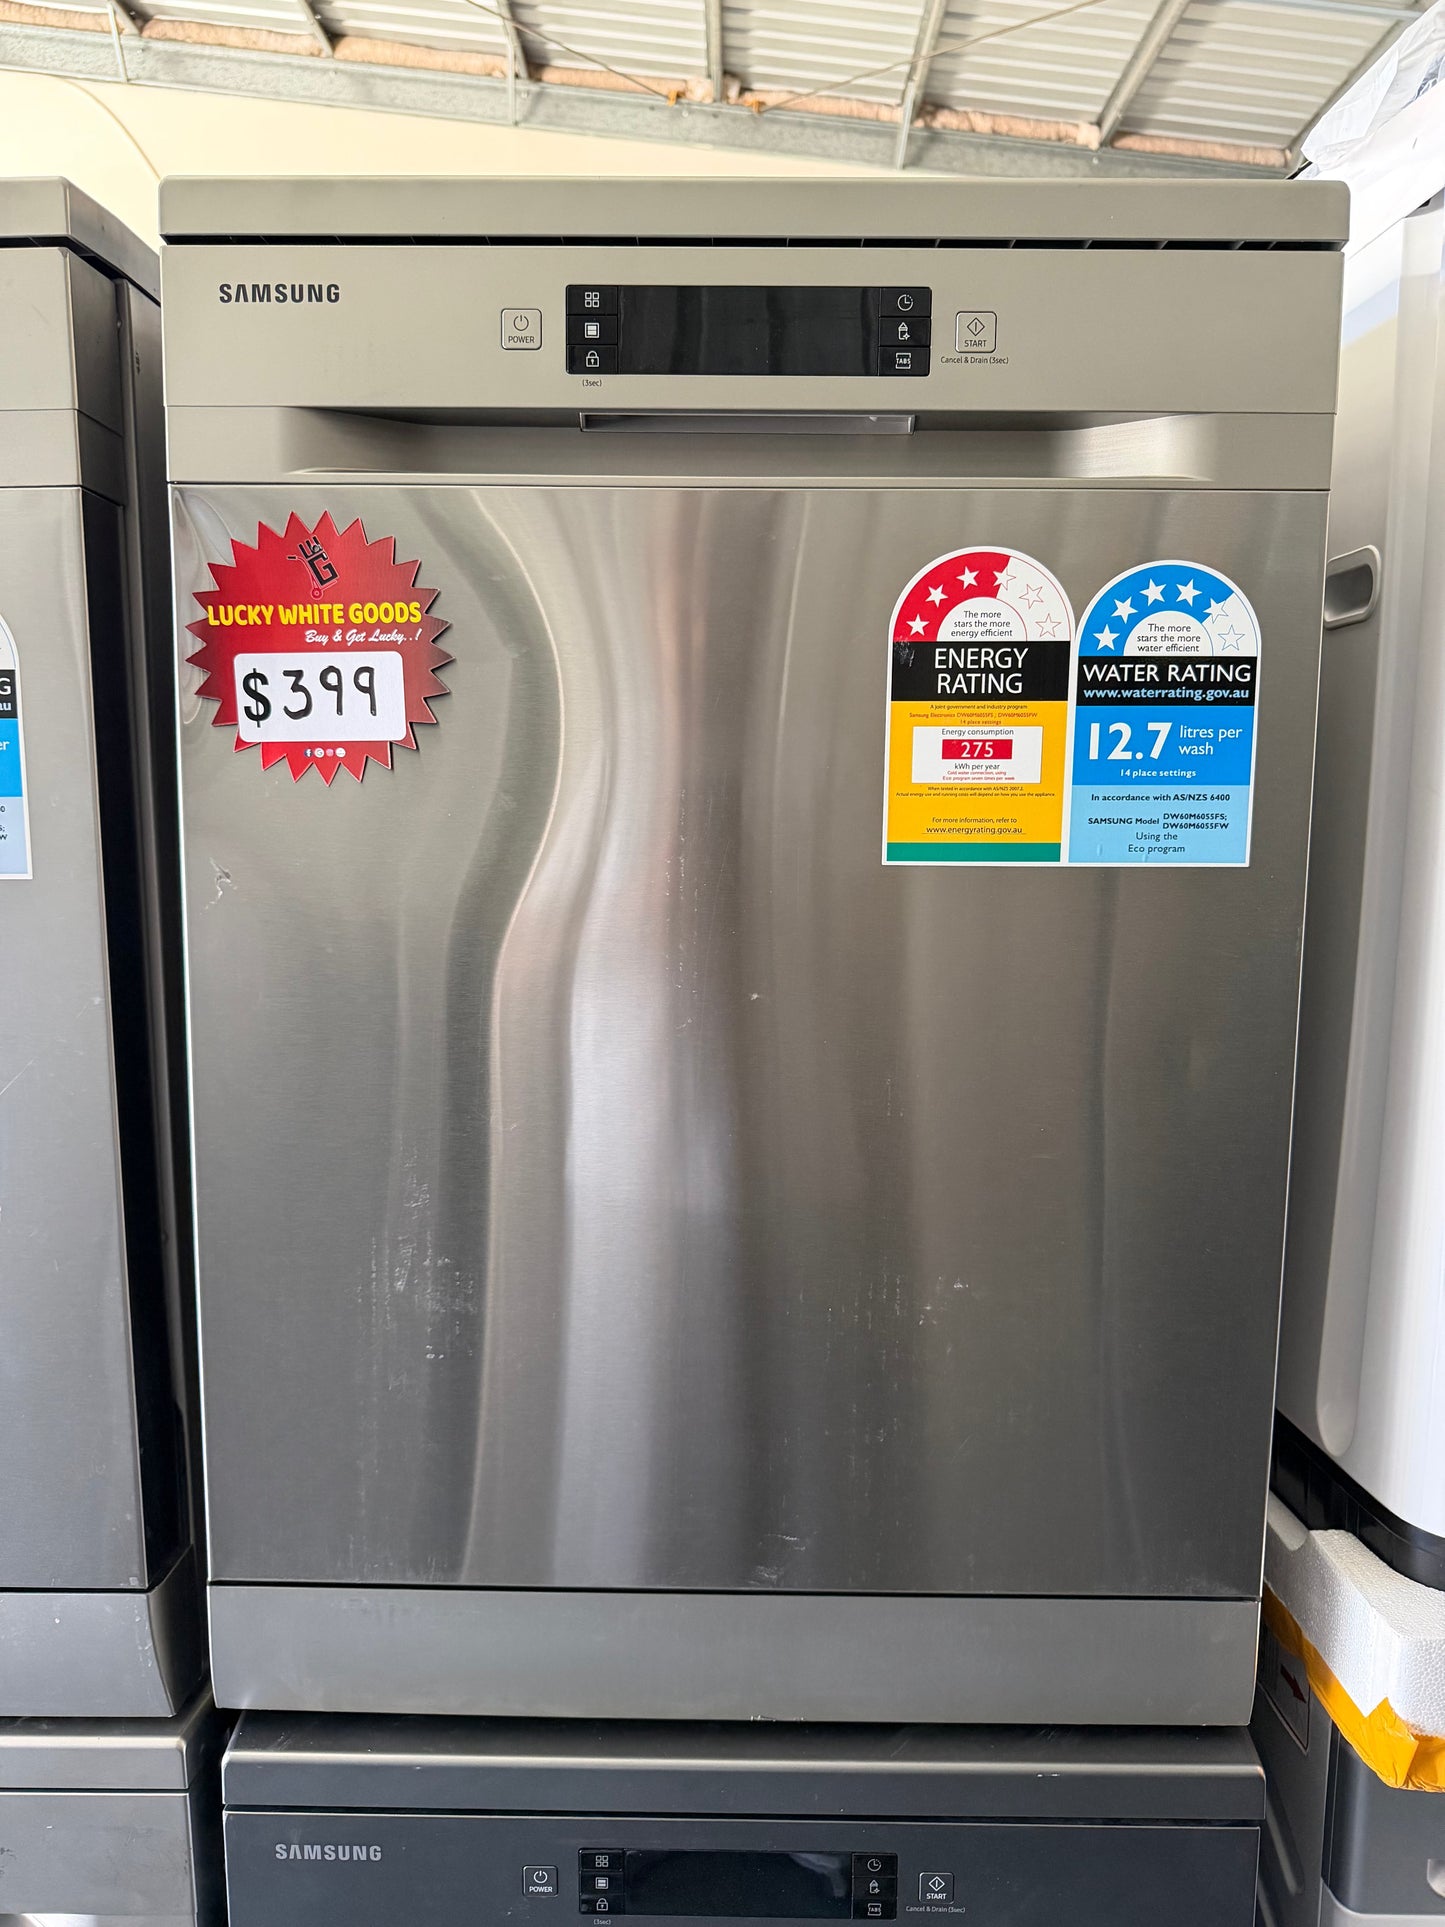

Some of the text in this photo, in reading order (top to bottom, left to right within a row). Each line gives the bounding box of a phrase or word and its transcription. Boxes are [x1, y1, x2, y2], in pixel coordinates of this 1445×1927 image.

[218, 283, 340, 304] SAMSUNG
[508, 336, 534, 344] POWER
[582, 379, 602, 388] (3sec)
[208, 602, 422, 626] LUCKY WHITE GOODS
[1148, 624, 1165, 632] The
[305, 630, 329, 645] Buy
[333, 630, 342, 642] &
[346, 629, 365, 645] Get
[1137, 644, 1199, 652] water efficient
[935, 648, 1029, 669] ENERGY
[1083, 664, 1251, 682] WATER RATING
[937, 673, 1023, 694] RATING
[242, 666, 376, 728] $399
[1084, 686, 1249, 701] www.waterrating.gov.au
[1089, 722, 1172, 760] 12.7
[1180, 725, 1242, 742] litres per
[961, 742, 993, 758] 275
[1179, 742, 1214, 755] wash
[1132, 769, 1157, 778] place
[1159, 769, 1196, 778] settings
[926, 826, 1022, 835] www.energyrating.gov.au
[1136, 832, 1160, 842] Using
[1128, 844, 1185, 854] Eco program
[275, 1844, 382, 1862] SAMSUNG
